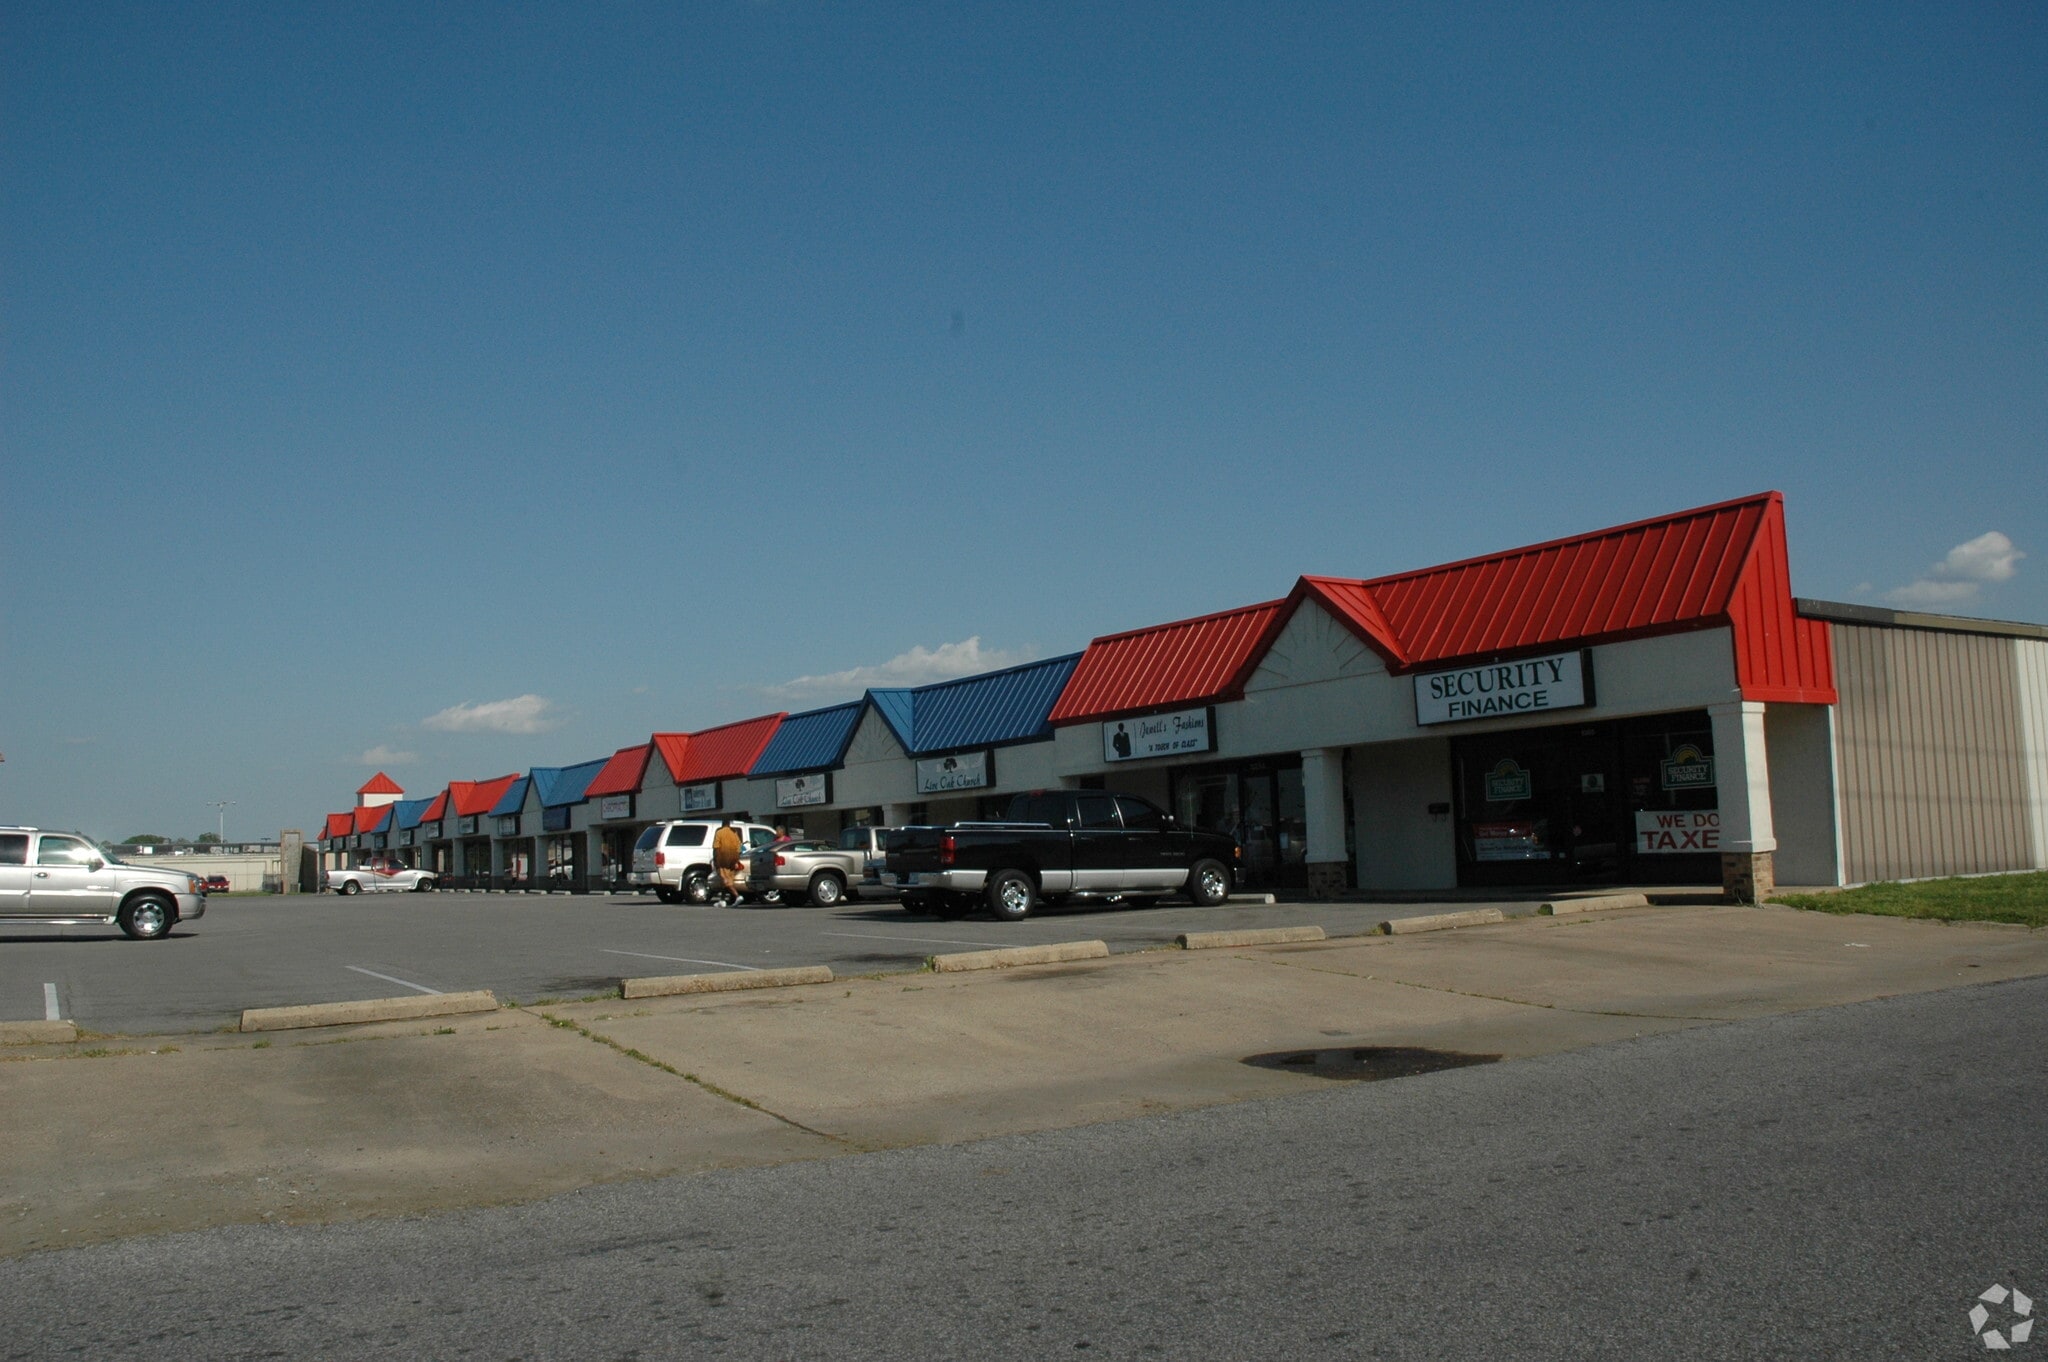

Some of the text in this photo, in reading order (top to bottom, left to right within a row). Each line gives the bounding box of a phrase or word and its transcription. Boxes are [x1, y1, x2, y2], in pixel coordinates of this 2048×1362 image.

[1430, 657, 1564, 700] SECURITY
[1448, 690, 1549, 718] FINANCE
[1172, 716, 1204, 734] Fashions
[1155, 742, 1169, 752] TOUCH
[1172, 741, 1179, 750] OF
[1668, 764, 1708, 774] SECURITY
[1671, 772, 1706, 782] FINANCE
[924, 773, 981, 791] Live Oak Church
[1657, 813, 1720, 828] WE DO
